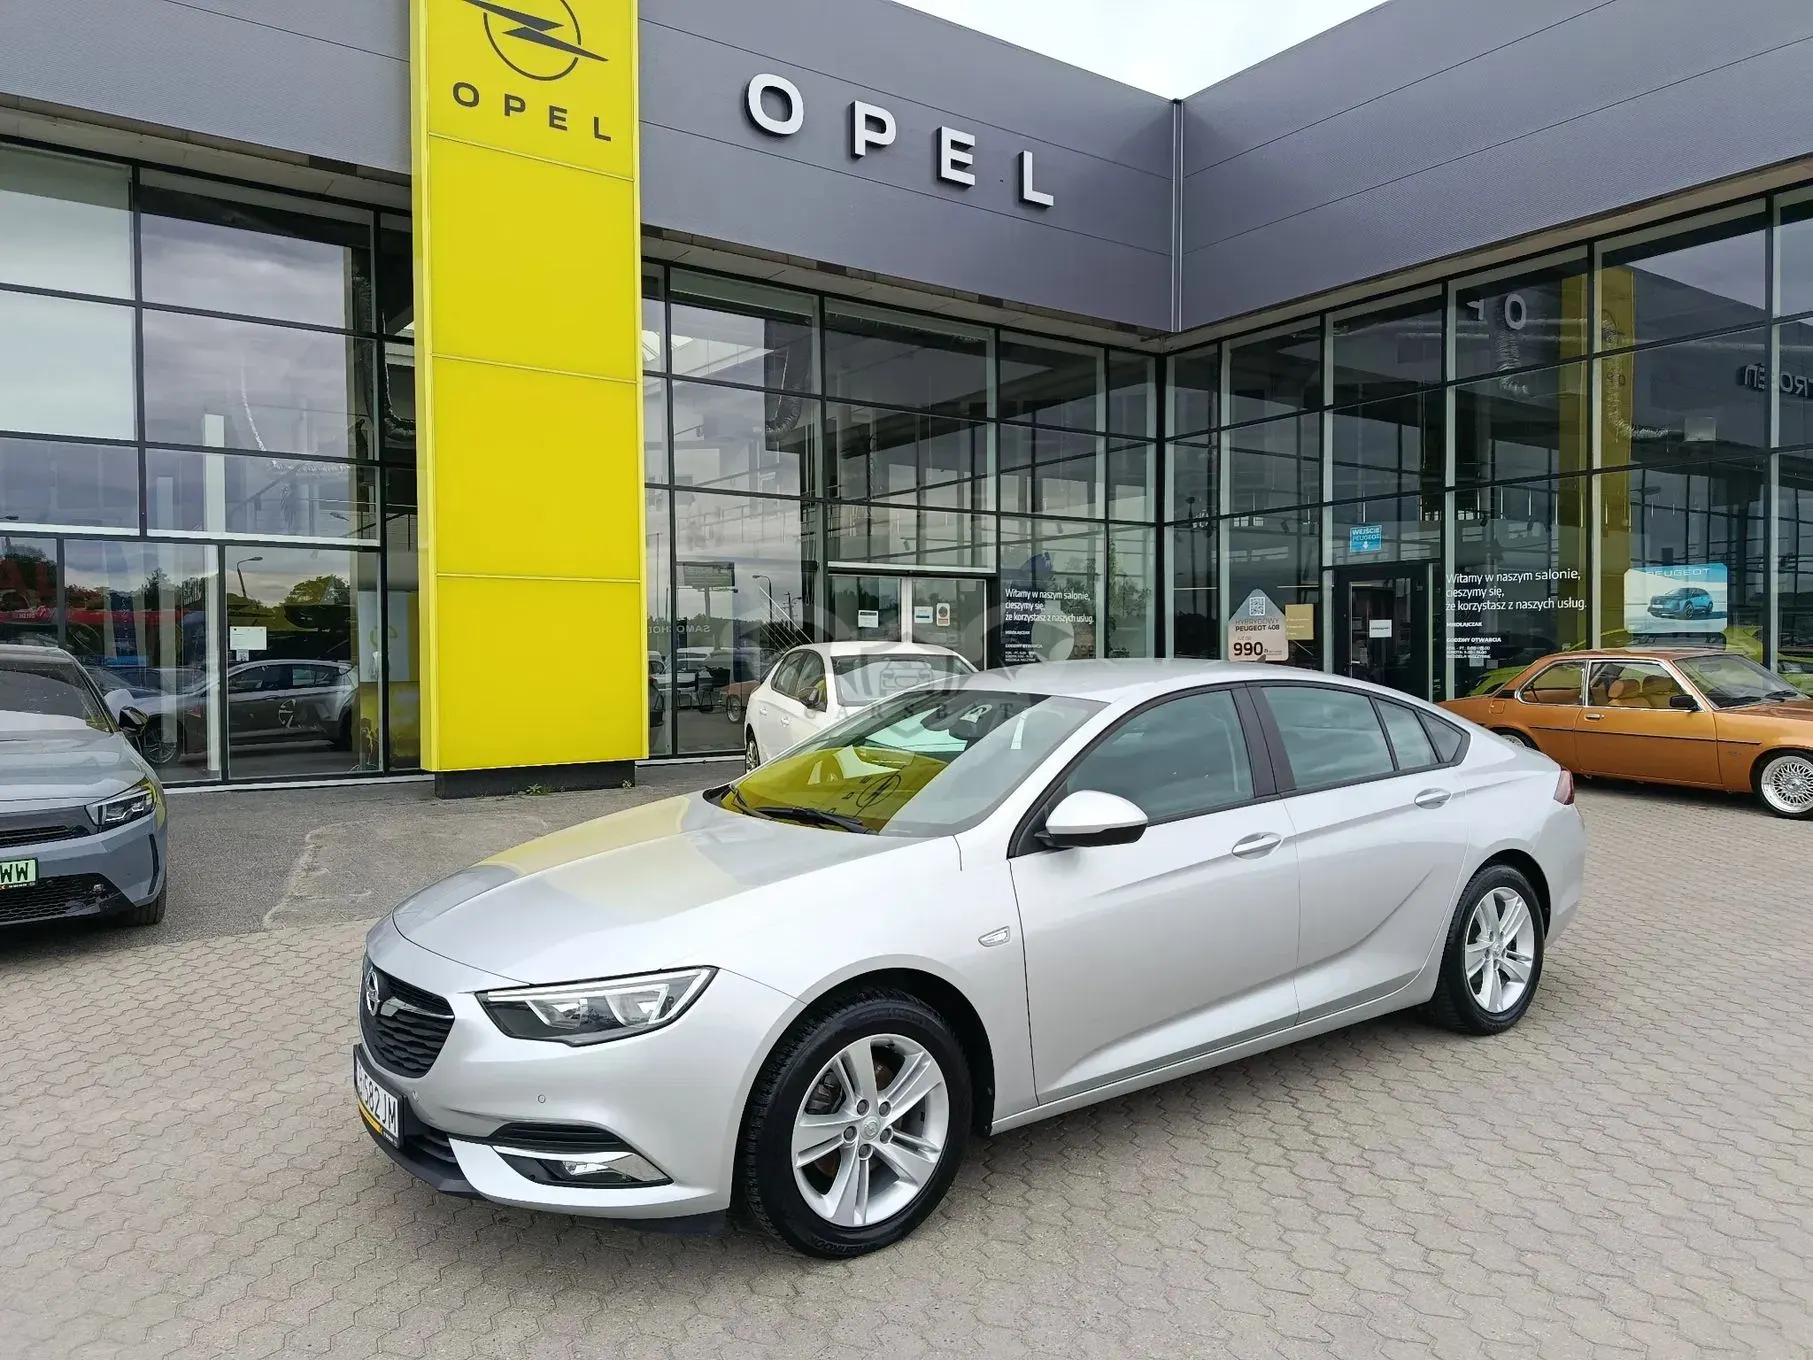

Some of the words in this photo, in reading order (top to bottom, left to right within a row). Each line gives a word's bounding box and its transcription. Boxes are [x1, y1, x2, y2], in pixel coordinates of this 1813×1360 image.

[452, 81, 612, 142] OPEL
[746, 73, 1054, 207] OPEL
[1446, 573, 1483, 584] Witamy
[1485, 575, 1495, 583] w
[1497, 572, 1533, 584] naszym
[1535, 568, 1581, 580] salonie,
[1005, 588, 1031, 599] Witamy
[1040, 592, 1062, 600] naszym
[1064, 590, 1090, 601] salonie,
[1446, 587, 1487, 599] cieszymy
[1488, 585, 1505, 598] się,
[1005, 602, 1034, 611] cieszymy
[1035, 601, 1045, 611] się,
[1446, 600, 1456, 611] że
[1458, 600, 1506, 613] korzystasz
[1508, 601, 1514, 610] z
[1516, 598, 1555, 611] naszych
[1557, 596, 1587, 611] usług.
[1005, 612, 1013, 621] że
[1013, 612, 1047, 623] korzystasz
[1052, 613, 1076, 623] naszych
[1076, 613, 1094, 625] usług.
[1233, 641, 1263, 656] 990
[0, 862, 28, 883] WW
[363, 1073, 397, 1135] 582JM
